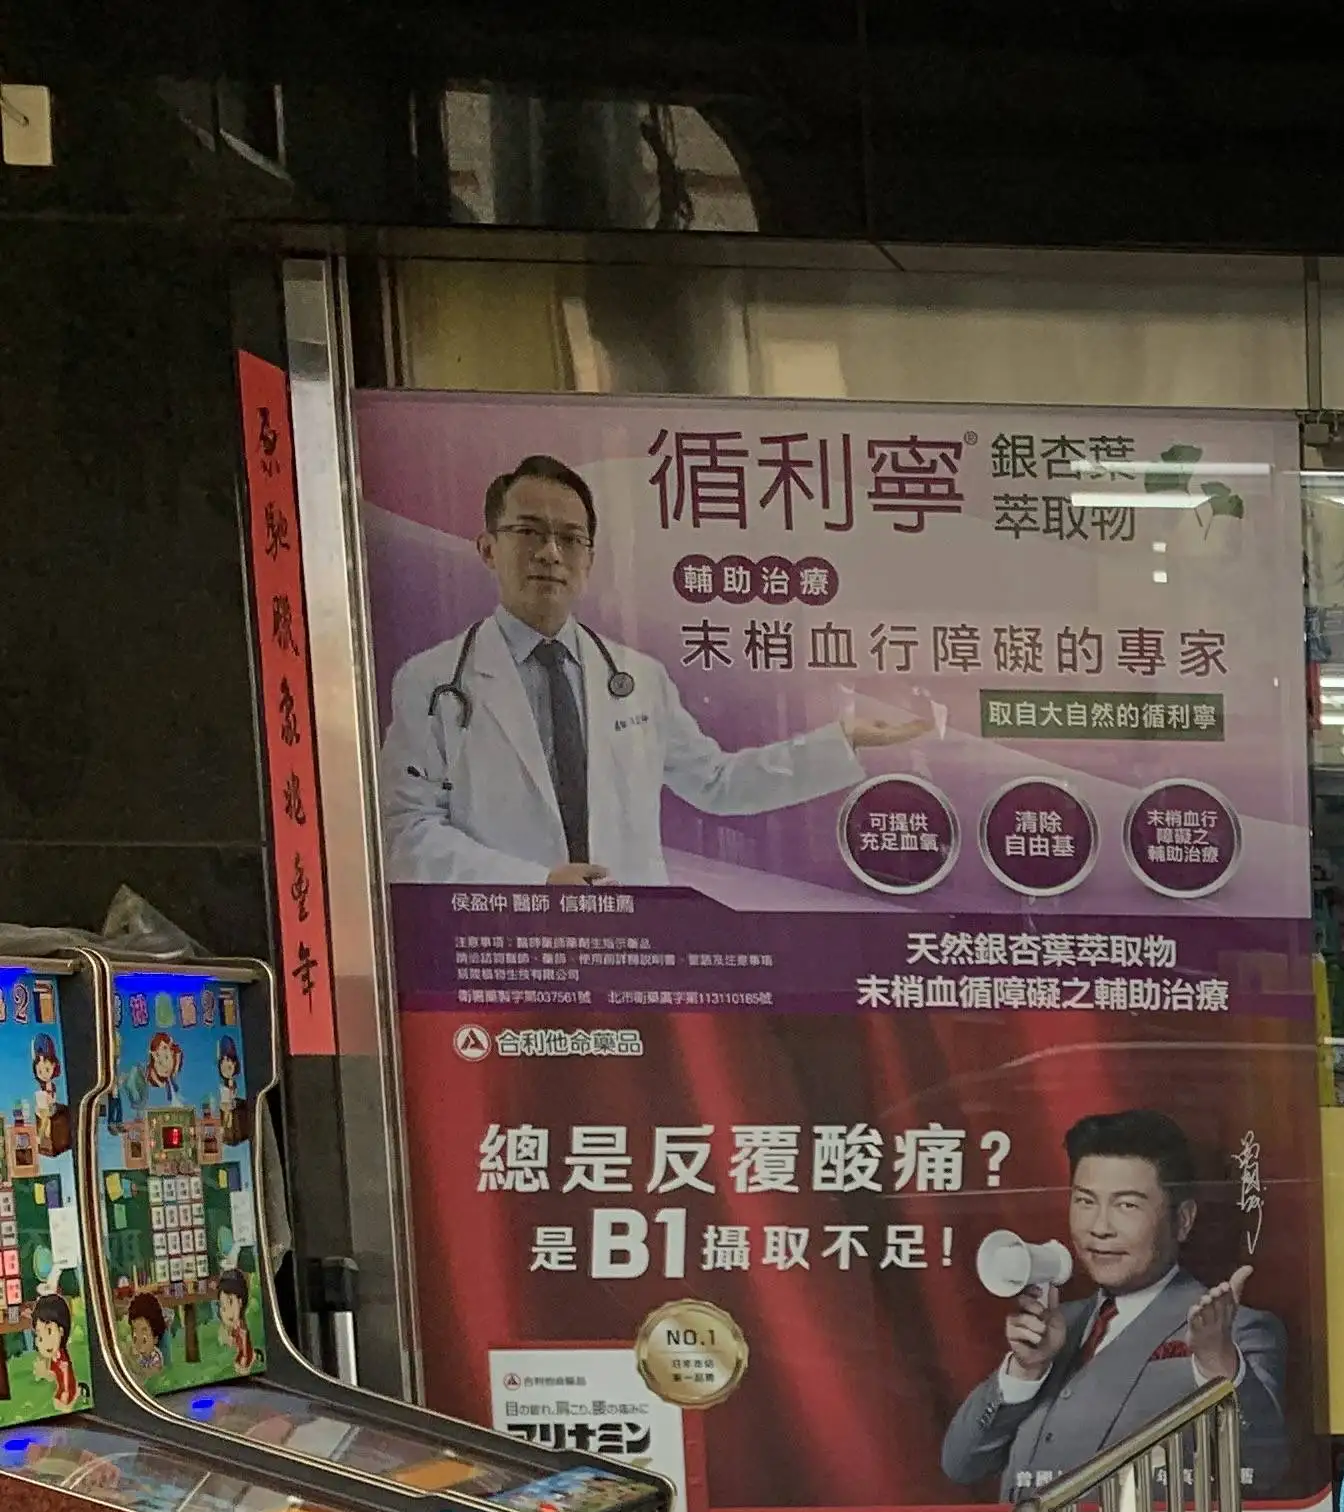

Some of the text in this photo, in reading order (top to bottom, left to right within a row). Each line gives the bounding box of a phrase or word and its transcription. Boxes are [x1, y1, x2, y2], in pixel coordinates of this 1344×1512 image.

[991, 433, 1136, 480] 銀杏葉
[647, 428, 965, 532] 循利寧
[992, 494, 1136, 541] 萃取物
[684, 565, 829, 598] 輔助治療
[681, 621, 1229, 677] 末梢血行障礙的專家
[989, 700, 1218, 731] 取自大自然的循利寧
[869, 812, 929, 832] 可提供
[1015, 811, 1063, 834] 清除
[1147, 809, 1218, 827] 末梢血行
[859, 832, 939, 853] 充足血氧
[1005, 834, 1076, 857] 自由基
[1156, 827, 1209, 845] 障礙之
[1147, 845, 1220, 863] 輔助治療
[451, 893, 635, 914] 侯盈仲 醫師 信賴推薦
[906, 932, 1177, 967] 天然銀杏葉萃取物
[855, 975, 1229, 1011] 末梢血循障礙之輔助治療
[496, 1029, 643, 1058] 合利他命藥品
[476, 1122, 1011, 1194] 總是反覆酸痛?
[529, 1206, 954, 1280] 是B1攝取不足!
[667, 1329, 717, 1346] NO.1
